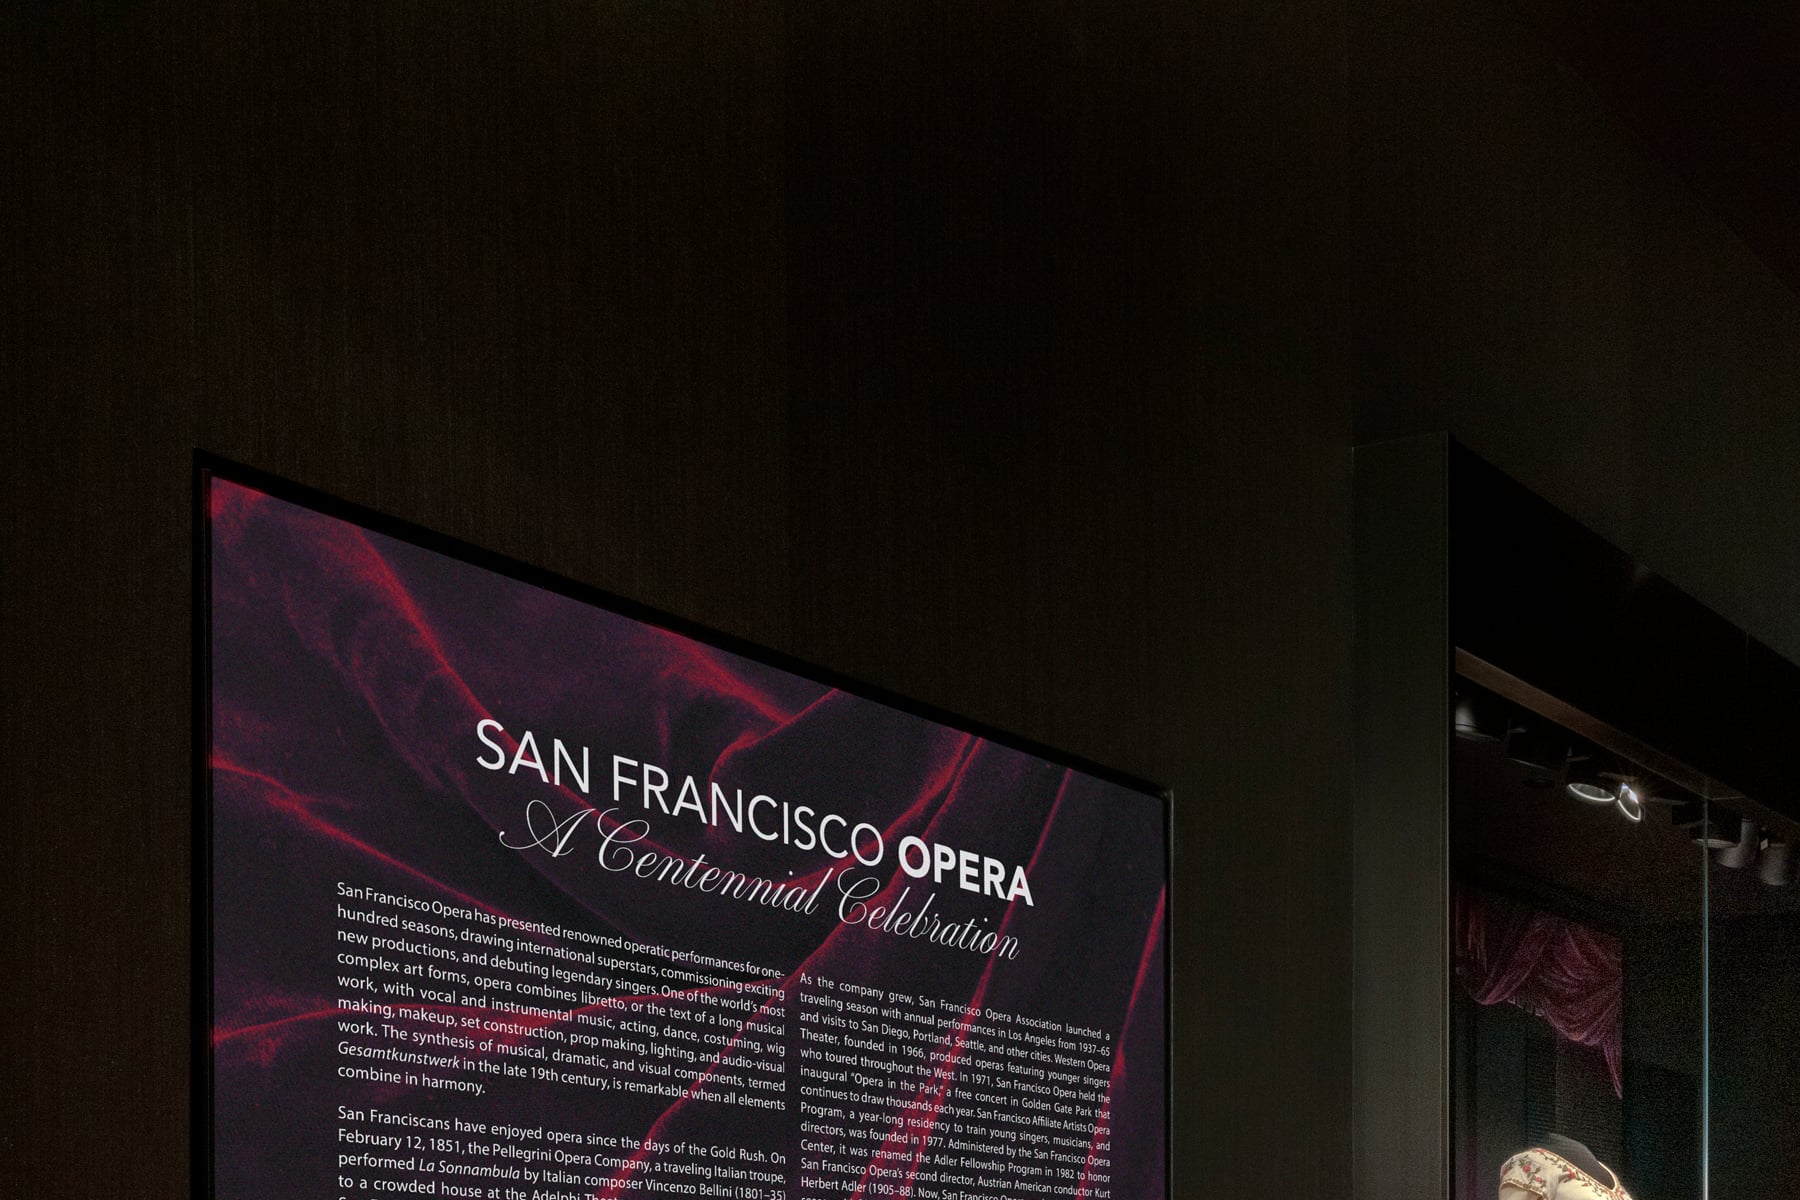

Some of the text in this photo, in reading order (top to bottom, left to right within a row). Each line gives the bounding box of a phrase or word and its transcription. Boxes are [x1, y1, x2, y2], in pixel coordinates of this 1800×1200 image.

[475, 718, 1034, 907] SAN FRANCISCO OPERA
[499, 799, 1020, 959] A Centennial Celebration
[337, 881, 785, 979] San Francisco Opera has presented renowned operatic performances for one-
[337, 903, 785, 1002] hundred seasons, drawing international superstars, commissioning exciting
[799, 971, 1110, 1041] As the company grew, San Francisco Opera Association launched a
[337, 1040, 786, 1111] Gesamtkunstwerk in the late 19th century, is remarkable when all elements
[337, 1064, 486, 1096] combine in harmony.
[337, 1105, 786, 1165] San Franciscans have enjoyed opera since the days of the Gold Rush. On
[338, 1127, 786, 1185] February 12, 1851, the Pellegrini Opera Company, a traveling Italian troupe,
